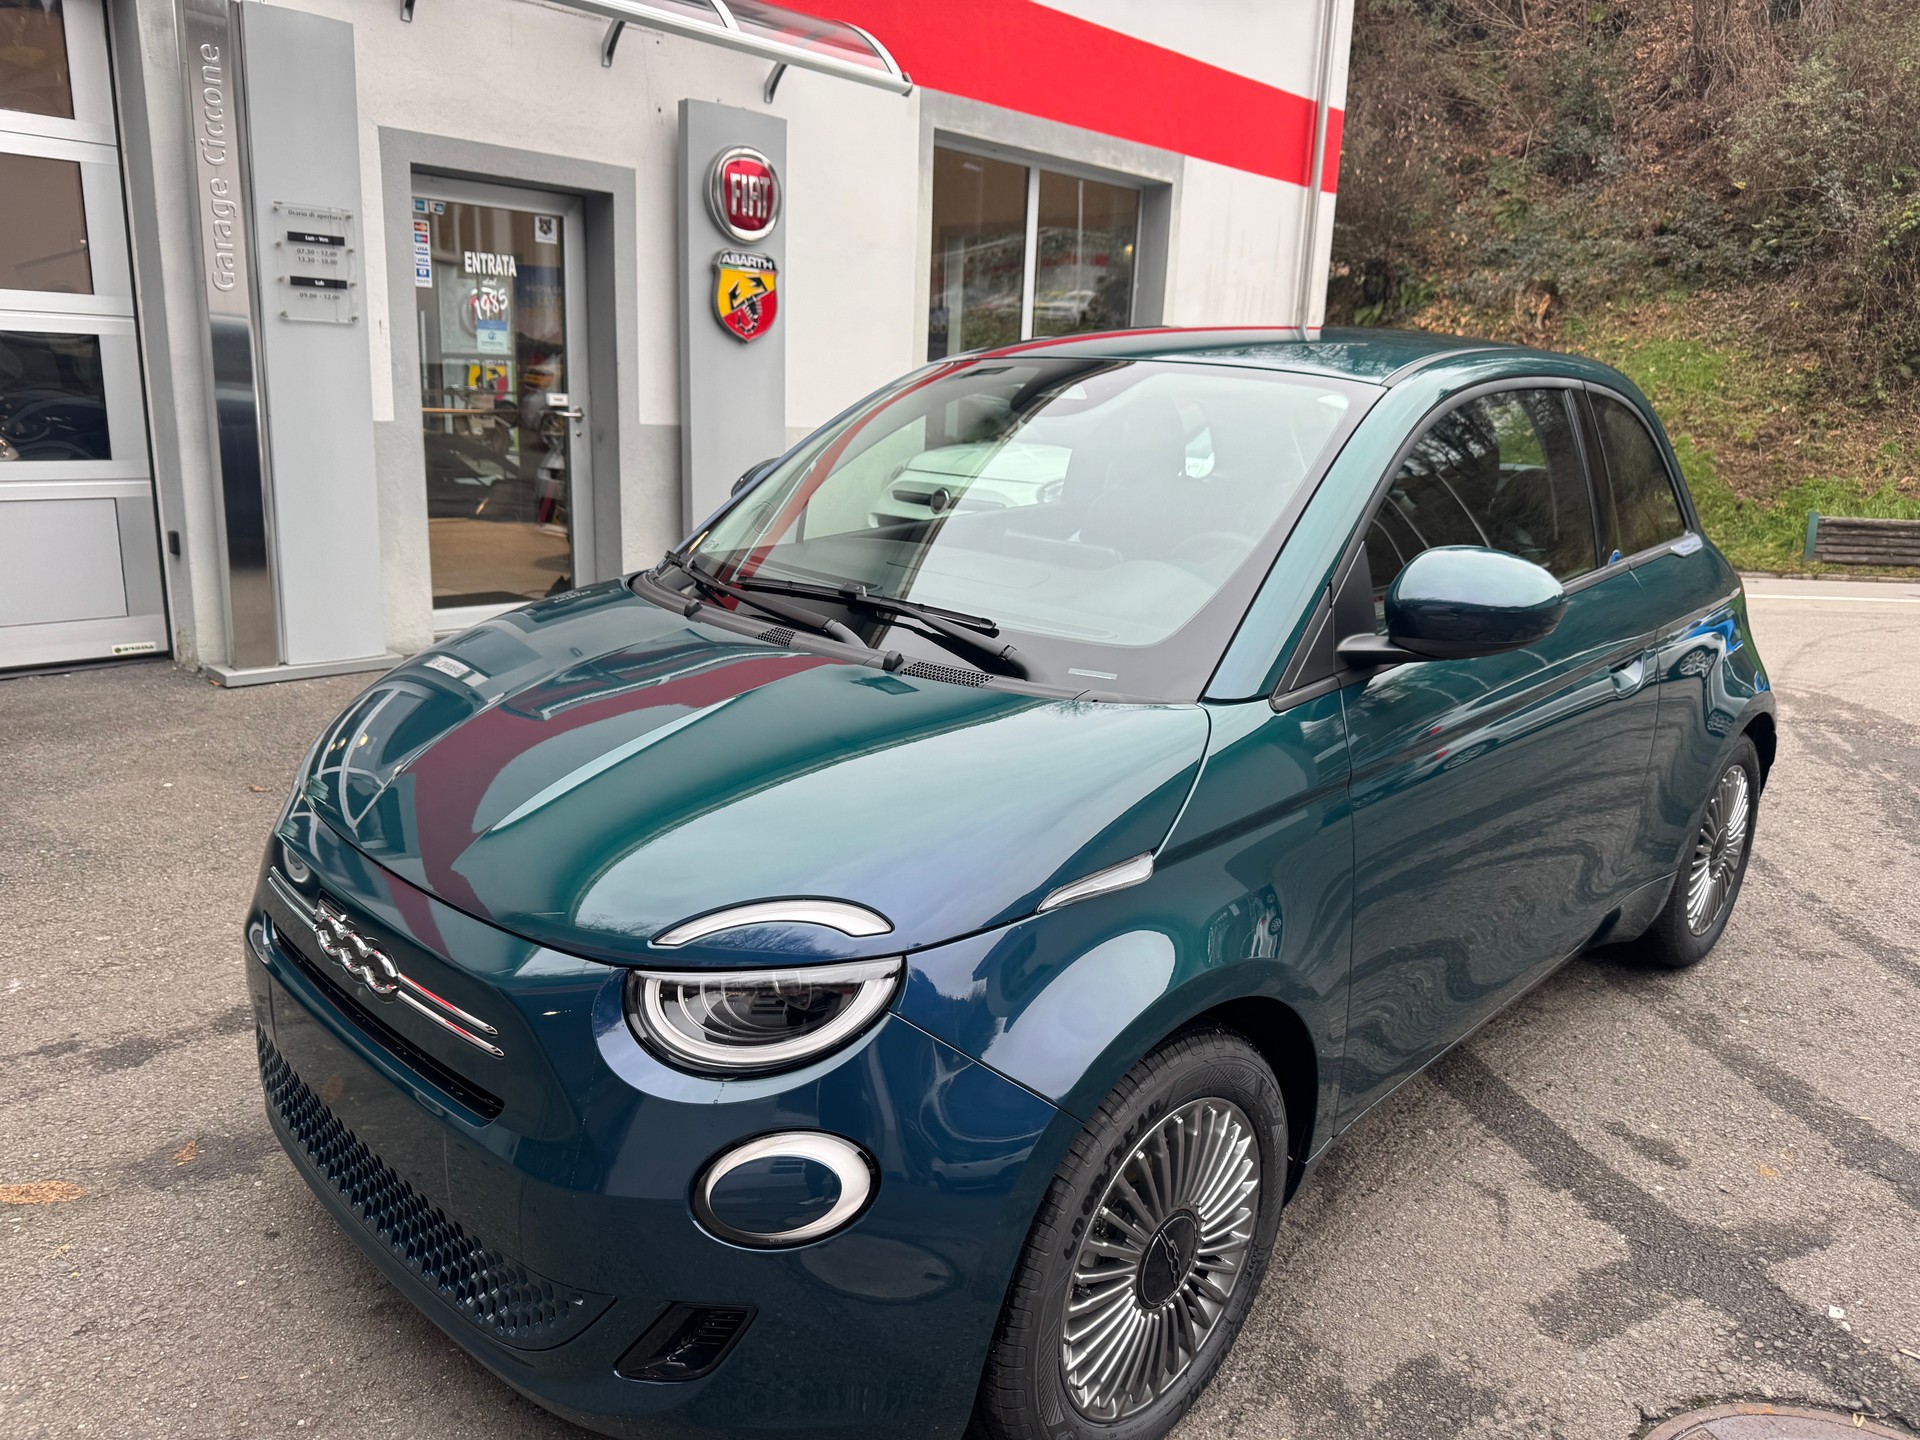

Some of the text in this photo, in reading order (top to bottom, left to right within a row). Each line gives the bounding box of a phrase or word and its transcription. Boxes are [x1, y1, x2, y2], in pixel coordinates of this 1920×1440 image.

[200, 43, 237, 292] Garage Ciccone
[729, 172, 771, 219] FIAT
[288, 209, 307, 217] Orario
[316, 212, 342, 221] apertura
[464, 250, 518, 277] ENTRATA
[721, 253, 773, 270] ABARTH
[471, 287, 509, 320] 1985
